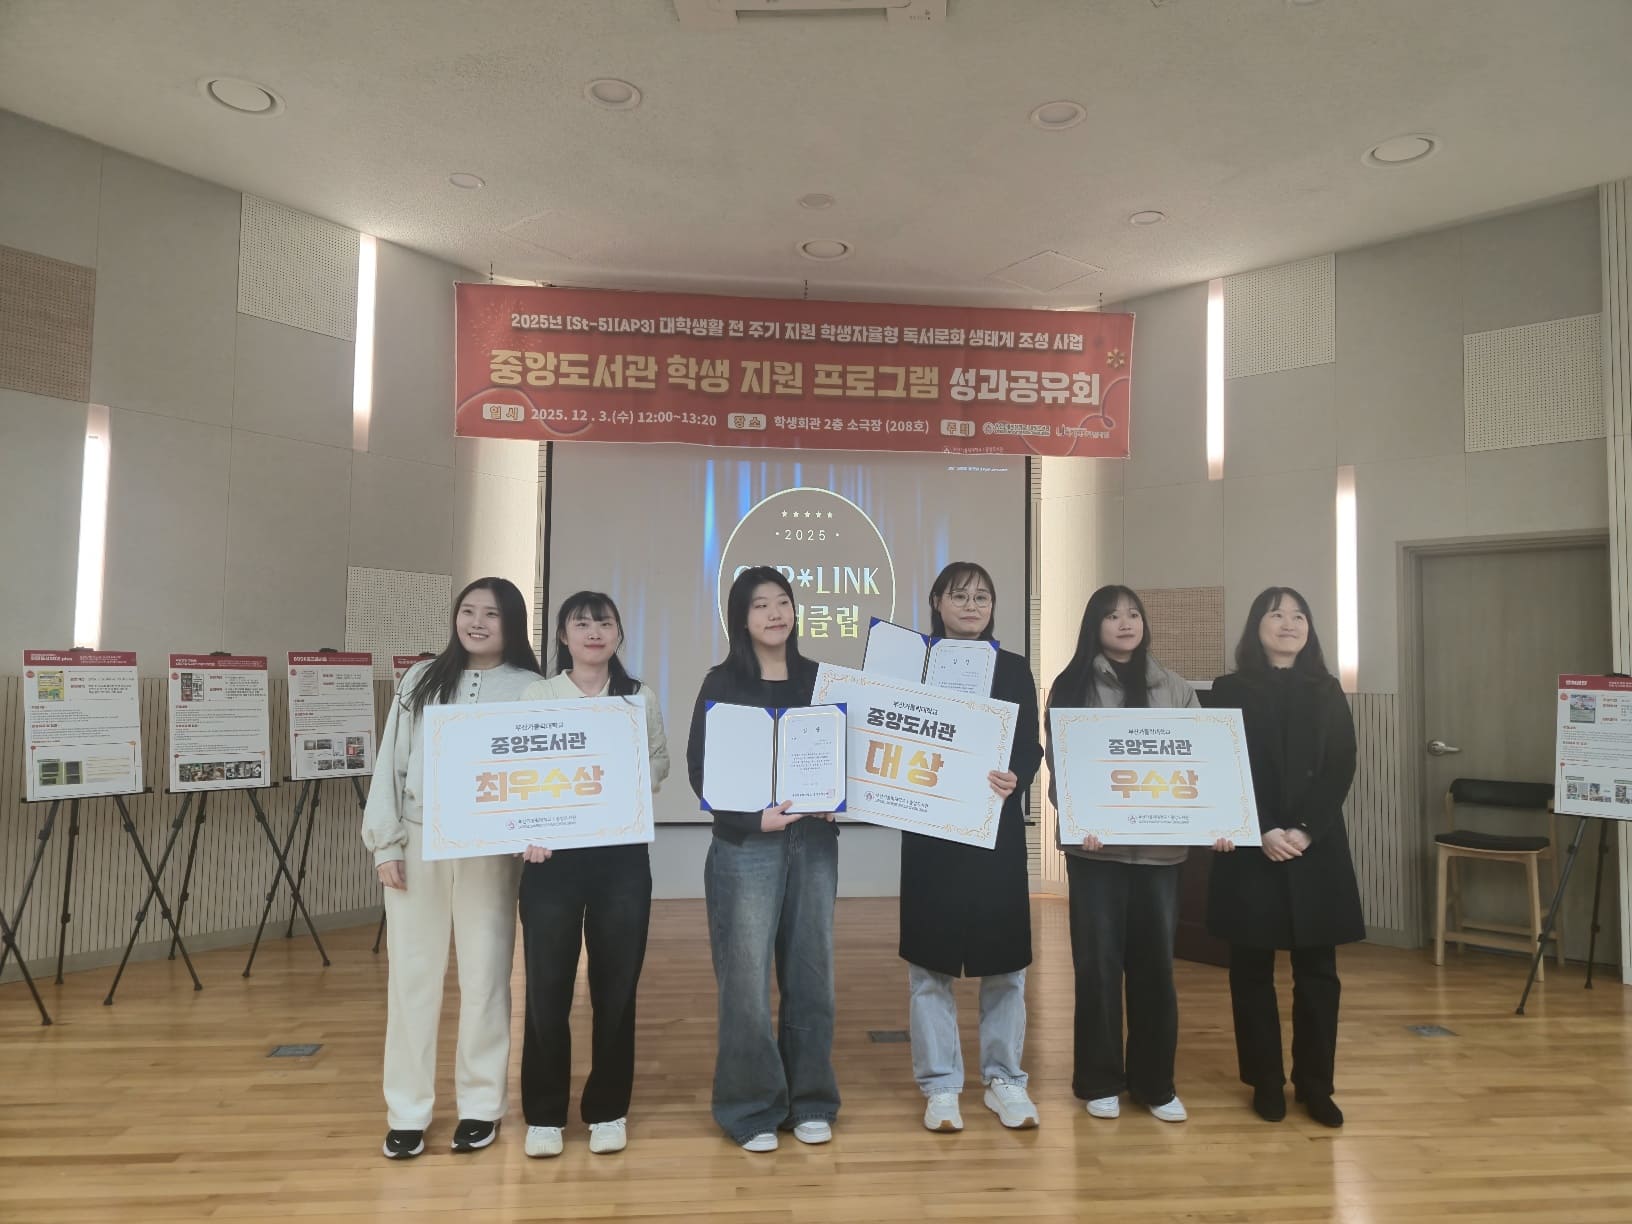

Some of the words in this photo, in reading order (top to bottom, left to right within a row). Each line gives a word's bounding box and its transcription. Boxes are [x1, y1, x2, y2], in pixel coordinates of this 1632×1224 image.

[511, 313, 562, 330] 2025년
[660, 316, 724, 337] 대학생활
[728, 320, 744, 337] 전
[748, 321, 779, 339] 주기
[785, 322, 816, 341] 지원
[820, 323, 898, 344] 학생자율형
[904, 327, 965, 346] 독서문화
[969, 329, 1014, 349] 생태계
[1018, 332, 1048, 350] 조성
[1053, 333, 1083, 351] 사업
[489, 349, 659, 391] 중앙도서관
[667, 354, 730, 394] 학생
[740, 360, 803, 396] 지원
[813, 362, 940, 399] 프로그램
[949, 367, 1100, 406] 성과공유회
[531, 409, 568, 422] 2025.
[638, 411, 717, 427] 12:00~13:20
[774, 416, 821, 431] 학생회관
[824, 417, 843, 431] 2층
[847, 418, 883, 433] 소극장
[886, 419, 930, 435] (208호)
[784, 529, 827, 542] 2025
[866, 707, 957, 743] 중앙도서관
[490, 731, 587, 755] 중앙도서관
[1108, 738, 1193, 756] 중앙도서관
[475, 765, 604, 804] 최우수상
[1110, 769, 1199, 800] 우수상
